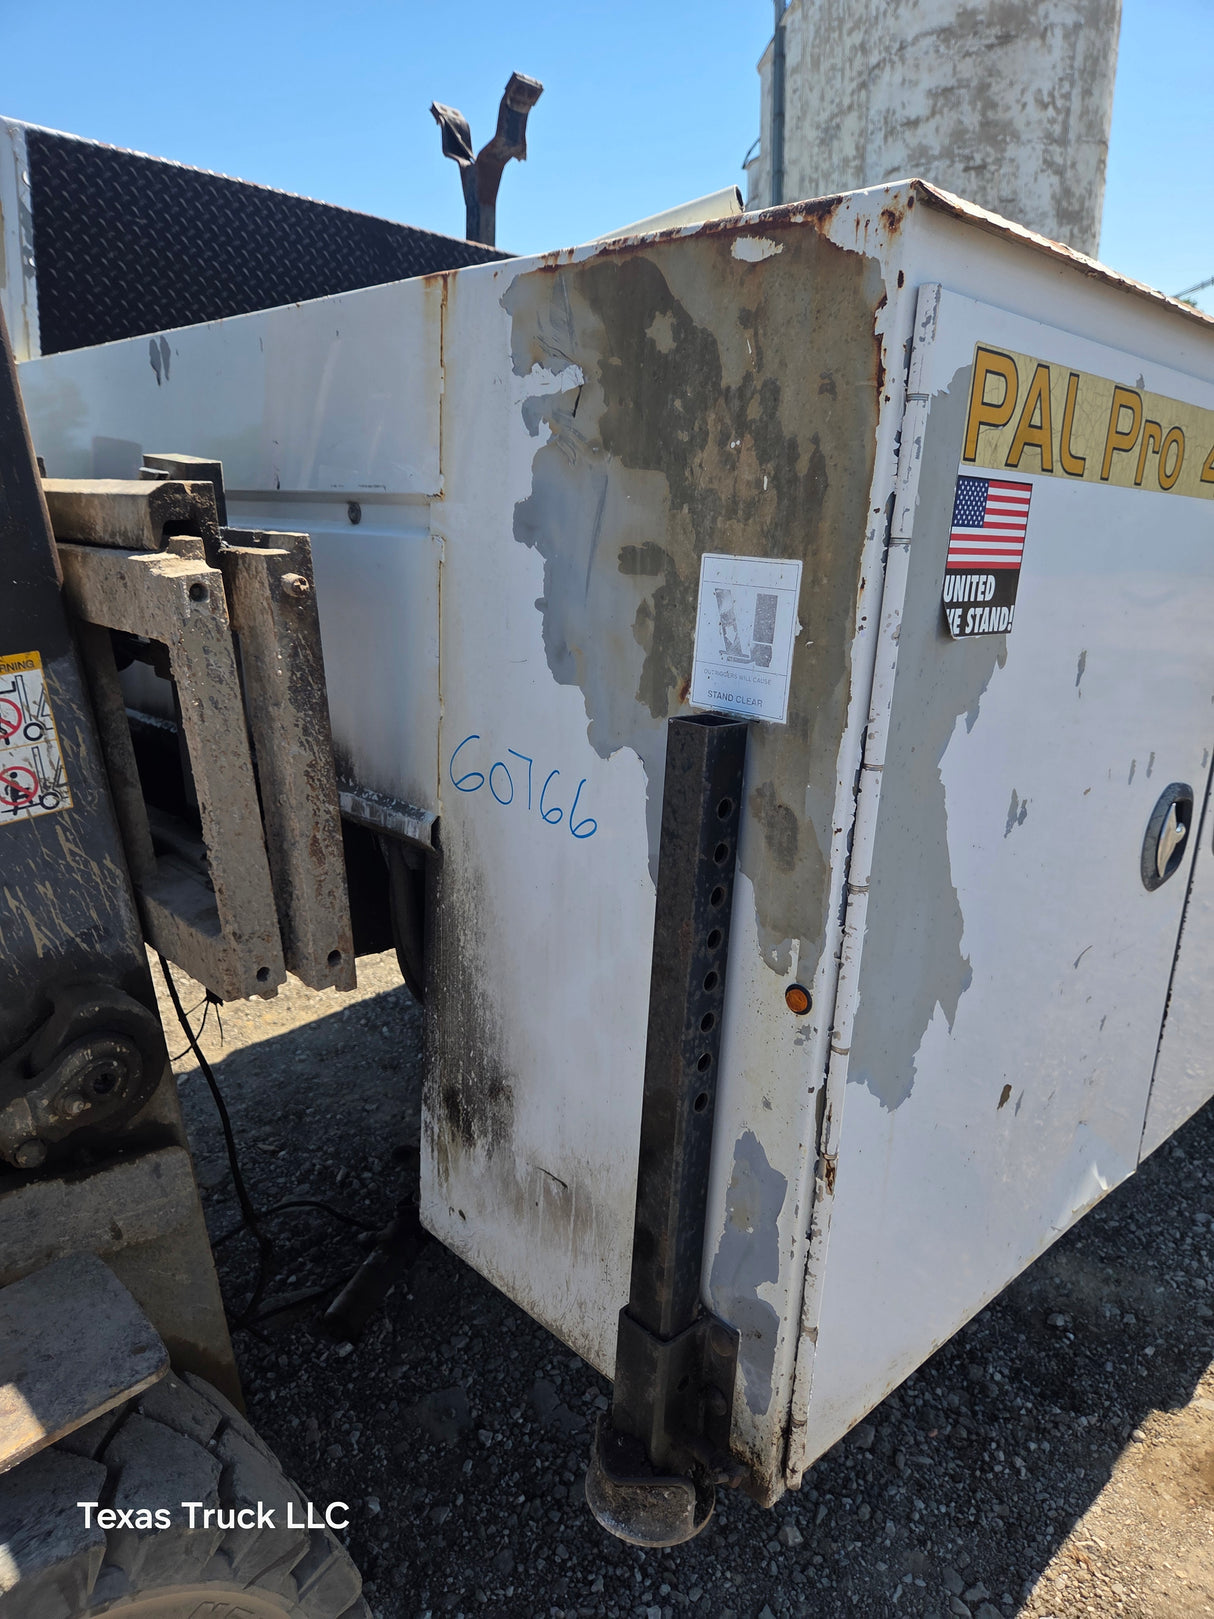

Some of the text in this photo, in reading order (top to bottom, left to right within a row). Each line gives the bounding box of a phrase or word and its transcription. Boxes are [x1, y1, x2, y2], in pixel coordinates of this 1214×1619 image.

[962, 346, 1185, 490] PAL Pro
[943, 575, 996, 603] UNITED
[965, 605, 1015, 634] STAND!
[752, 676, 772, 686] CAUSE
[707, 689, 763, 707] STAND CLEAR
[450, 735, 598, 839] 60766
